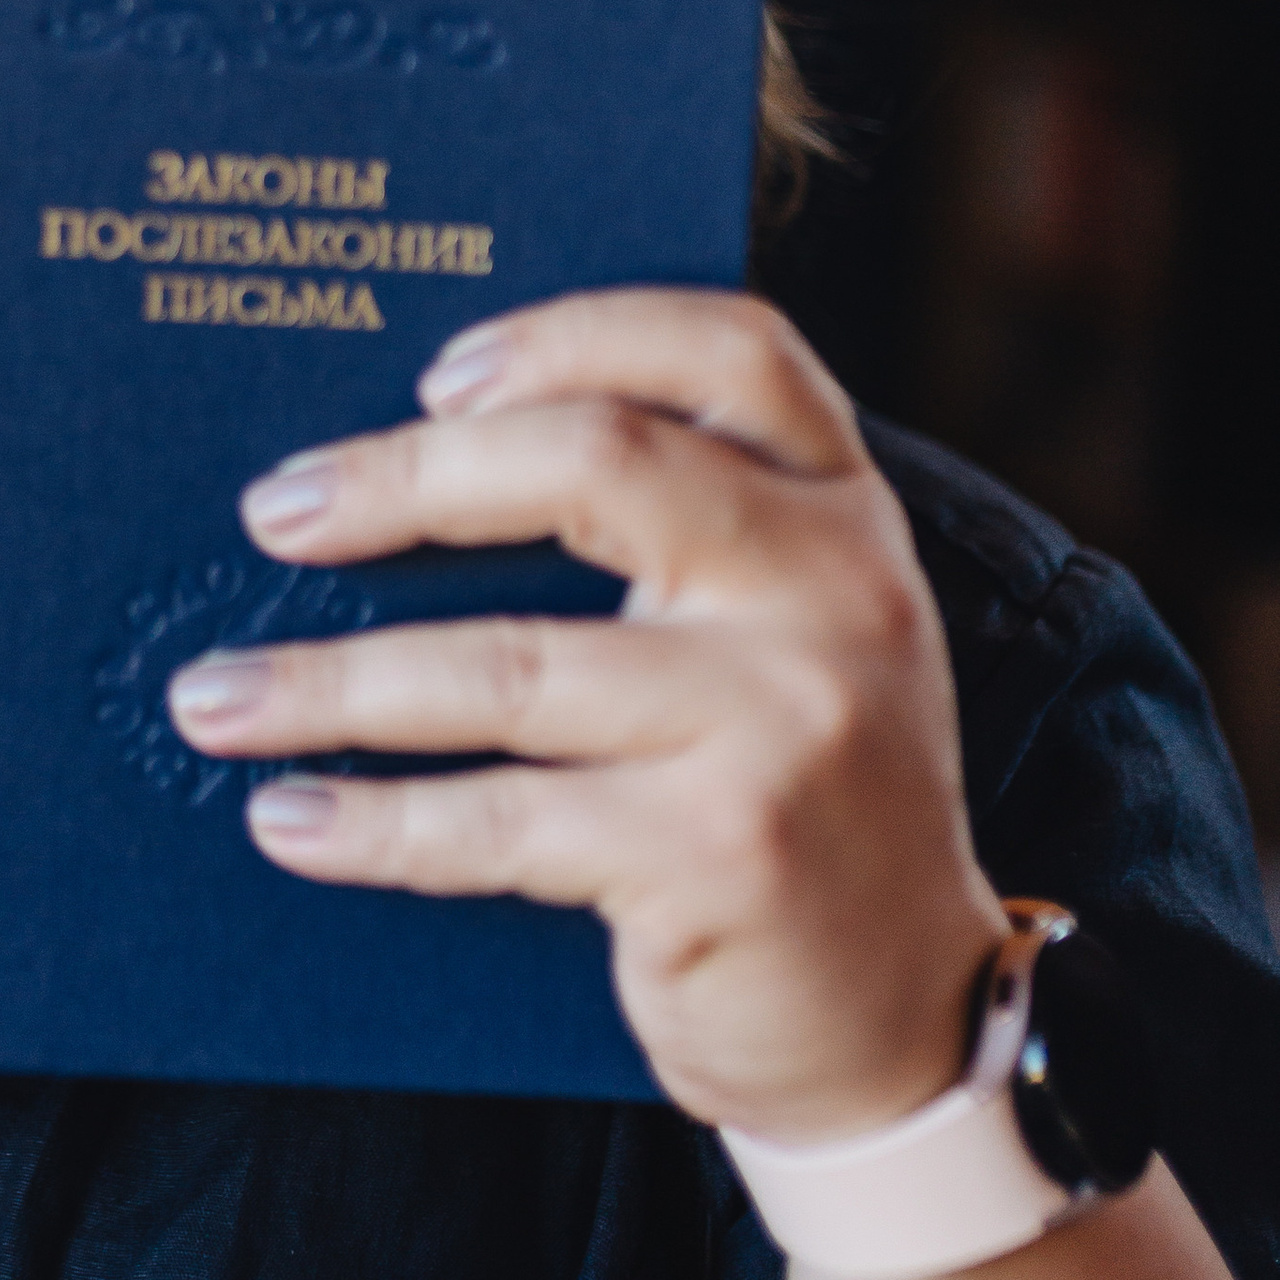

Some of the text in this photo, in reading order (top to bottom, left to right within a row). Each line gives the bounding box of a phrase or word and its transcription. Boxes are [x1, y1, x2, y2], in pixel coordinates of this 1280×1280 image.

[144, 149, 390, 210] ЗАКОНЫ
[40, 206, 494, 276] ПОСЛЕЗАКОНИЕ
[143, 271, 386, 332] ПИСЬМА
